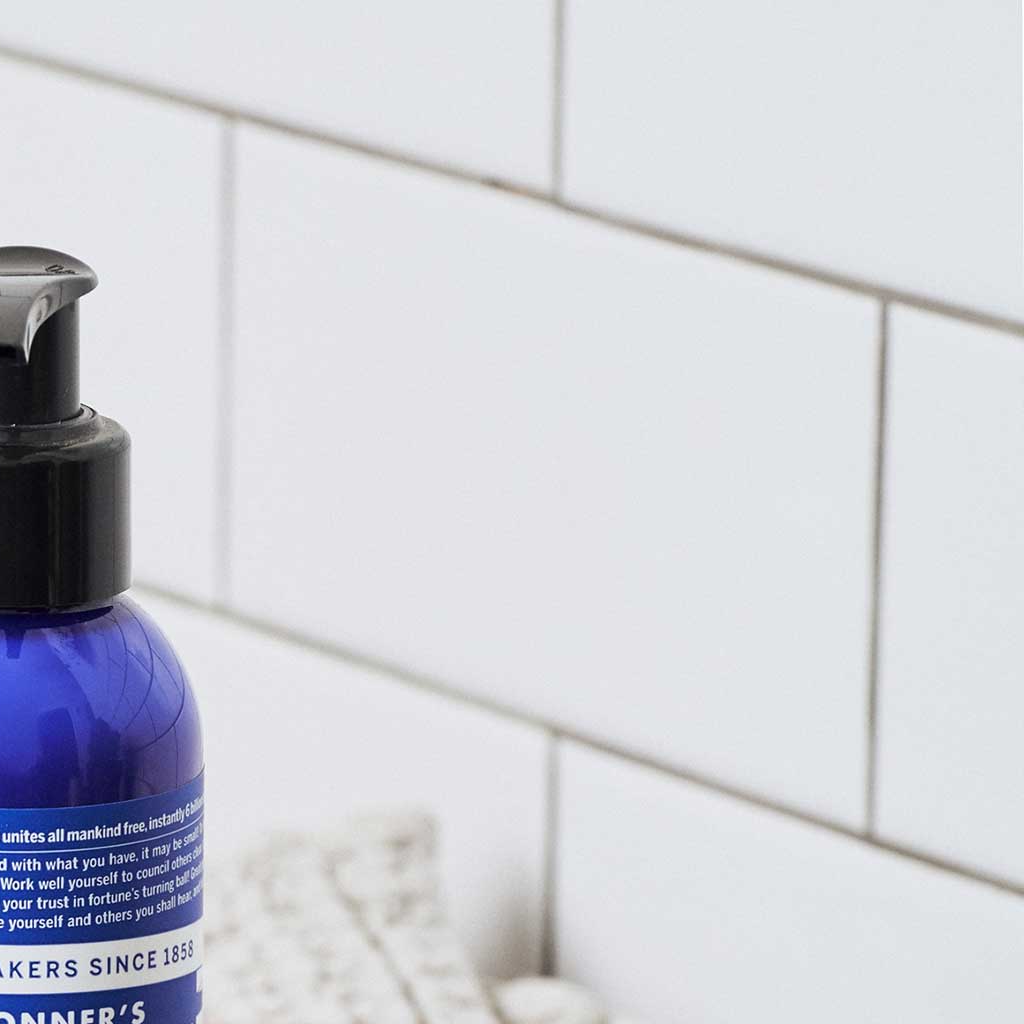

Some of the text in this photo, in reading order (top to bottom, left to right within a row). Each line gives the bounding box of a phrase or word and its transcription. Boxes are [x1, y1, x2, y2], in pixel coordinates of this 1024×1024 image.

[2, 830, 46, 843] unites
[48, 828, 64, 842] all
[67, 823, 121, 841] mankind
[149, 808, 185, 830] instantly
[12, 858, 41, 871] with
[46, 857, 78, 870] what
[83, 857, 105, 871] you
[142, 847, 149, 859] it
[152, 843, 170, 858] may
[173, 838, 182, 851] be
[0, 877, 34, 890] Work
[39, 877, 64, 890] well
[68, 871, 118, 892] yourself
[122, 869, 133, 882] to
[136, 860, 169, 880] council
[3, 899, 33, 912] your
[37, 896, 69, 910] trust
[74, 895, 85, 908] in
[88, 888, 139, 907] fortune's
[142, 881, 174, 897] turning
[8, 915, 63, 932] yourself
[68, 913, 91, 927] and
[96, 910, 133, 925] others
[136, 906, 154, 921] you
[157, 896, 175, 913] shall
[89, 950, 156, 976] SINCE
[163, 939, 194, 965] 1858
